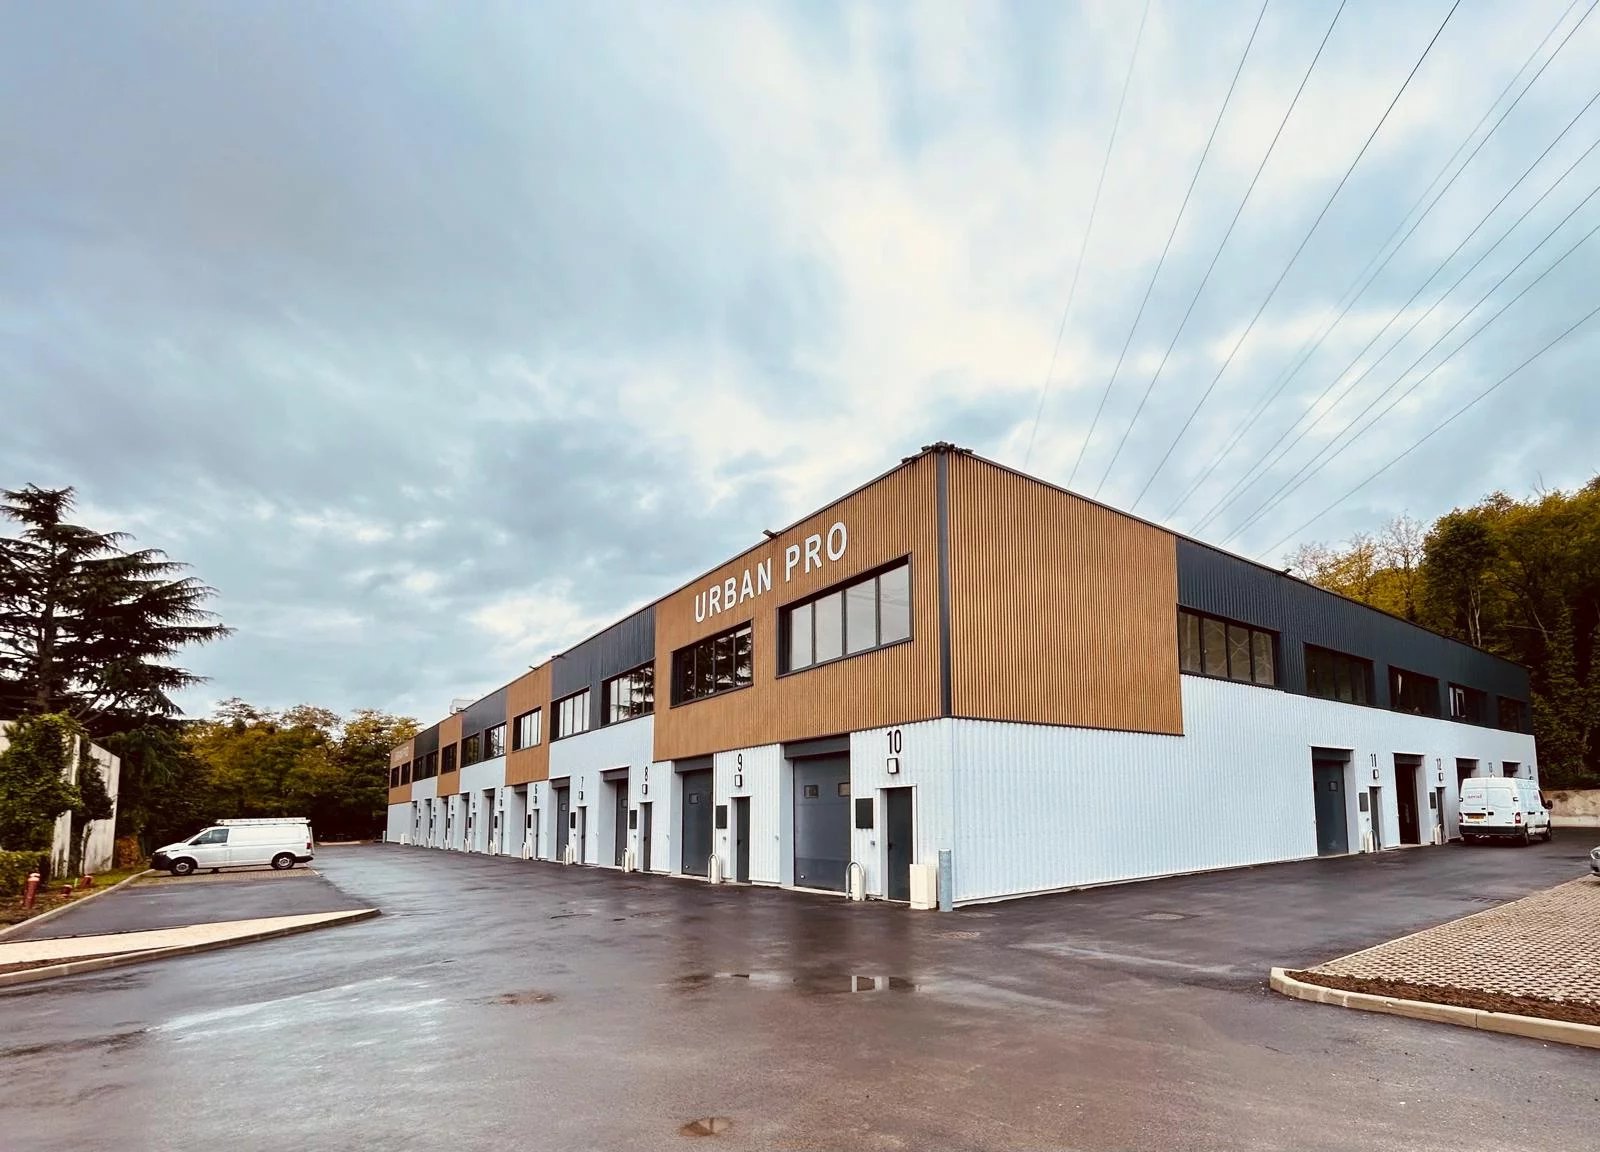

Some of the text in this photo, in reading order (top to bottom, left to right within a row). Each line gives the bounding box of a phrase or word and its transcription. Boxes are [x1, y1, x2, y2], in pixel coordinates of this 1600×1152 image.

[694, 522, 847, 623] URBAN PRO
[887, 729, 902, 755] 10
[737, 753, 743, 772] 9
[1370, 753, 1377, 767] 11
